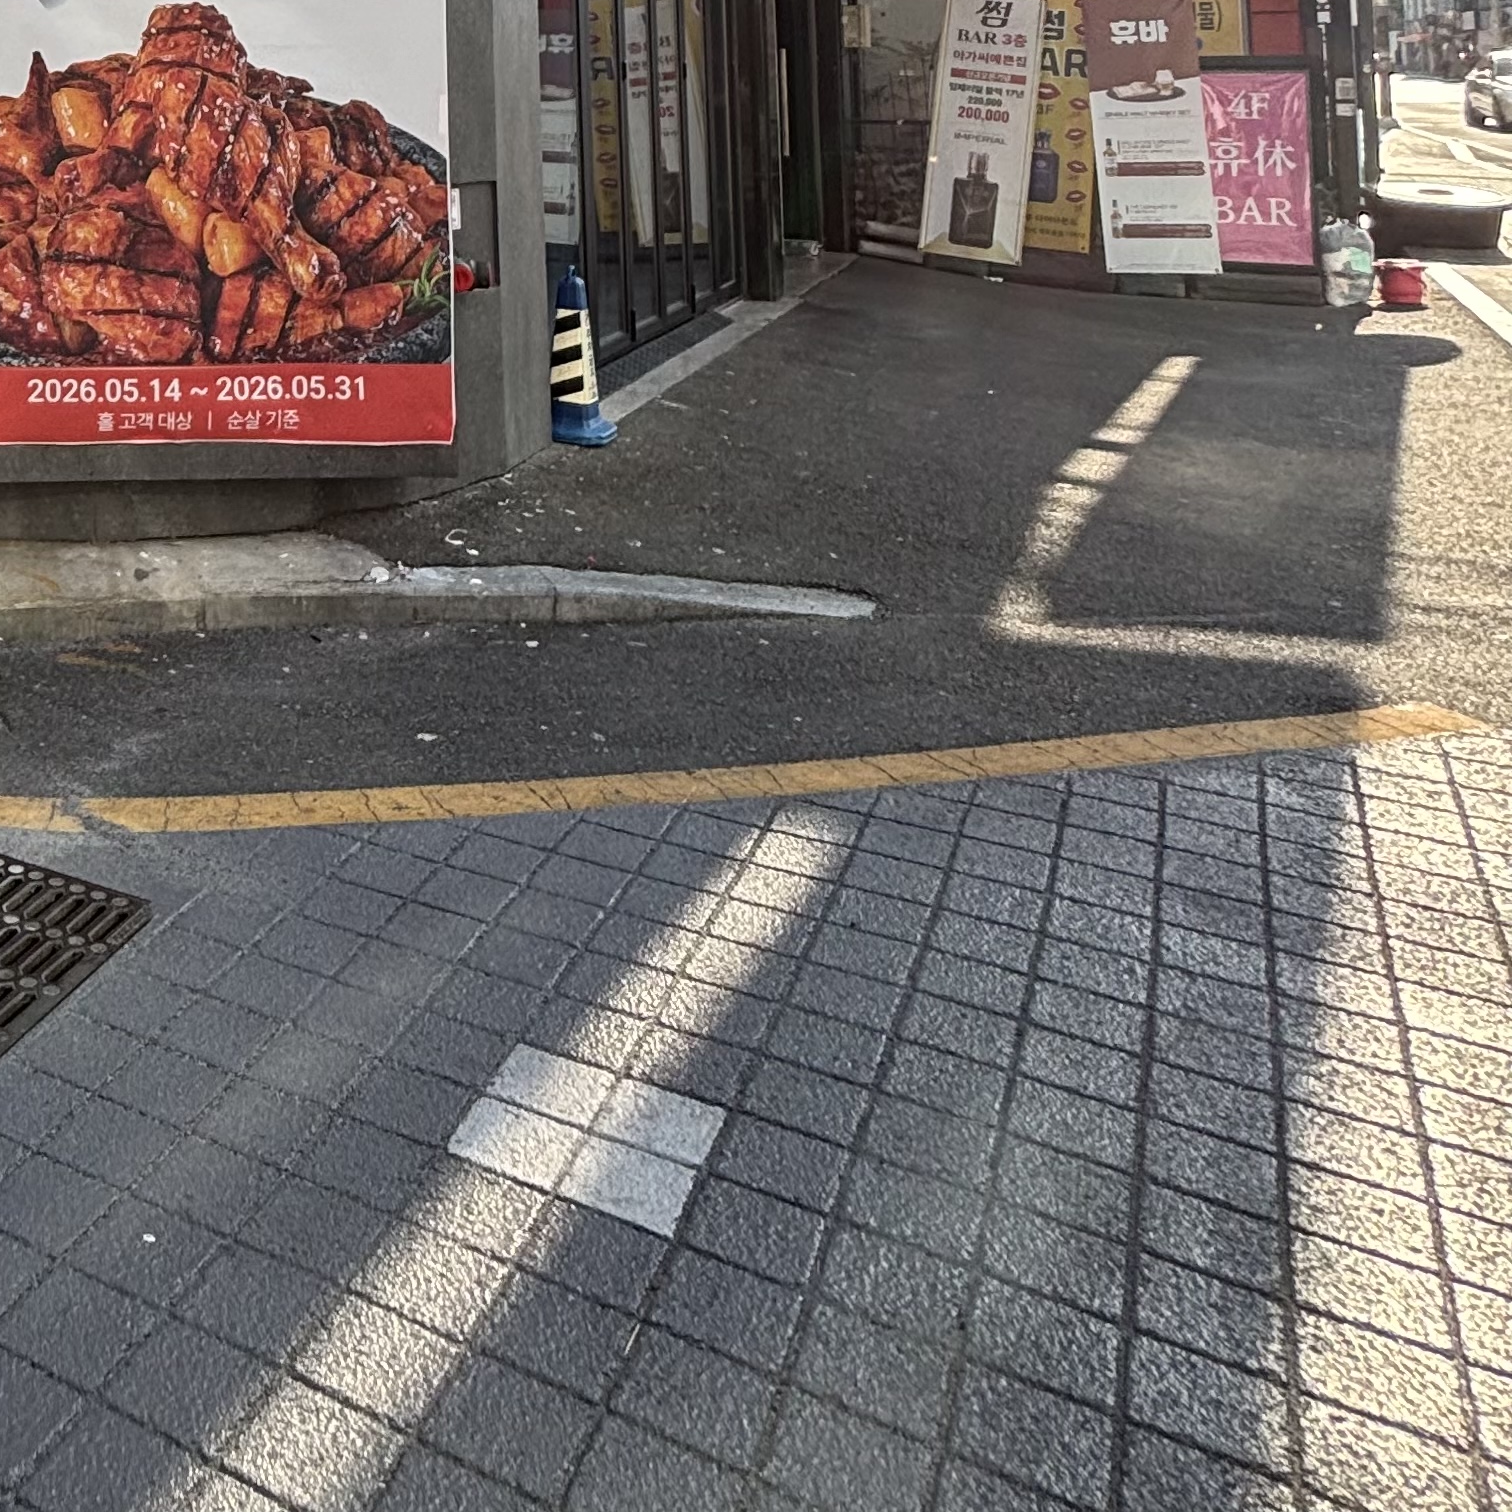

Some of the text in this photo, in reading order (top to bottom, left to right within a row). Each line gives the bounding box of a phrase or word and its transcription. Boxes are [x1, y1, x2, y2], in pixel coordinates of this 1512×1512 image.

[957, 29, 1028, 48] BAR 3층
[1109, 20, 1170, 45] 휴바
[957, 106, 1010, 124] 200,000
[1226, 91, 1271, 122] 4F
[1211, 196, 1298, 228] BAR
[26, 377, 183, 405] 2026.05.14
[216, 374, 367, 402] 2026.05.31
[97, 408, 301, 433] 홀 고객 대상 순살 기준
